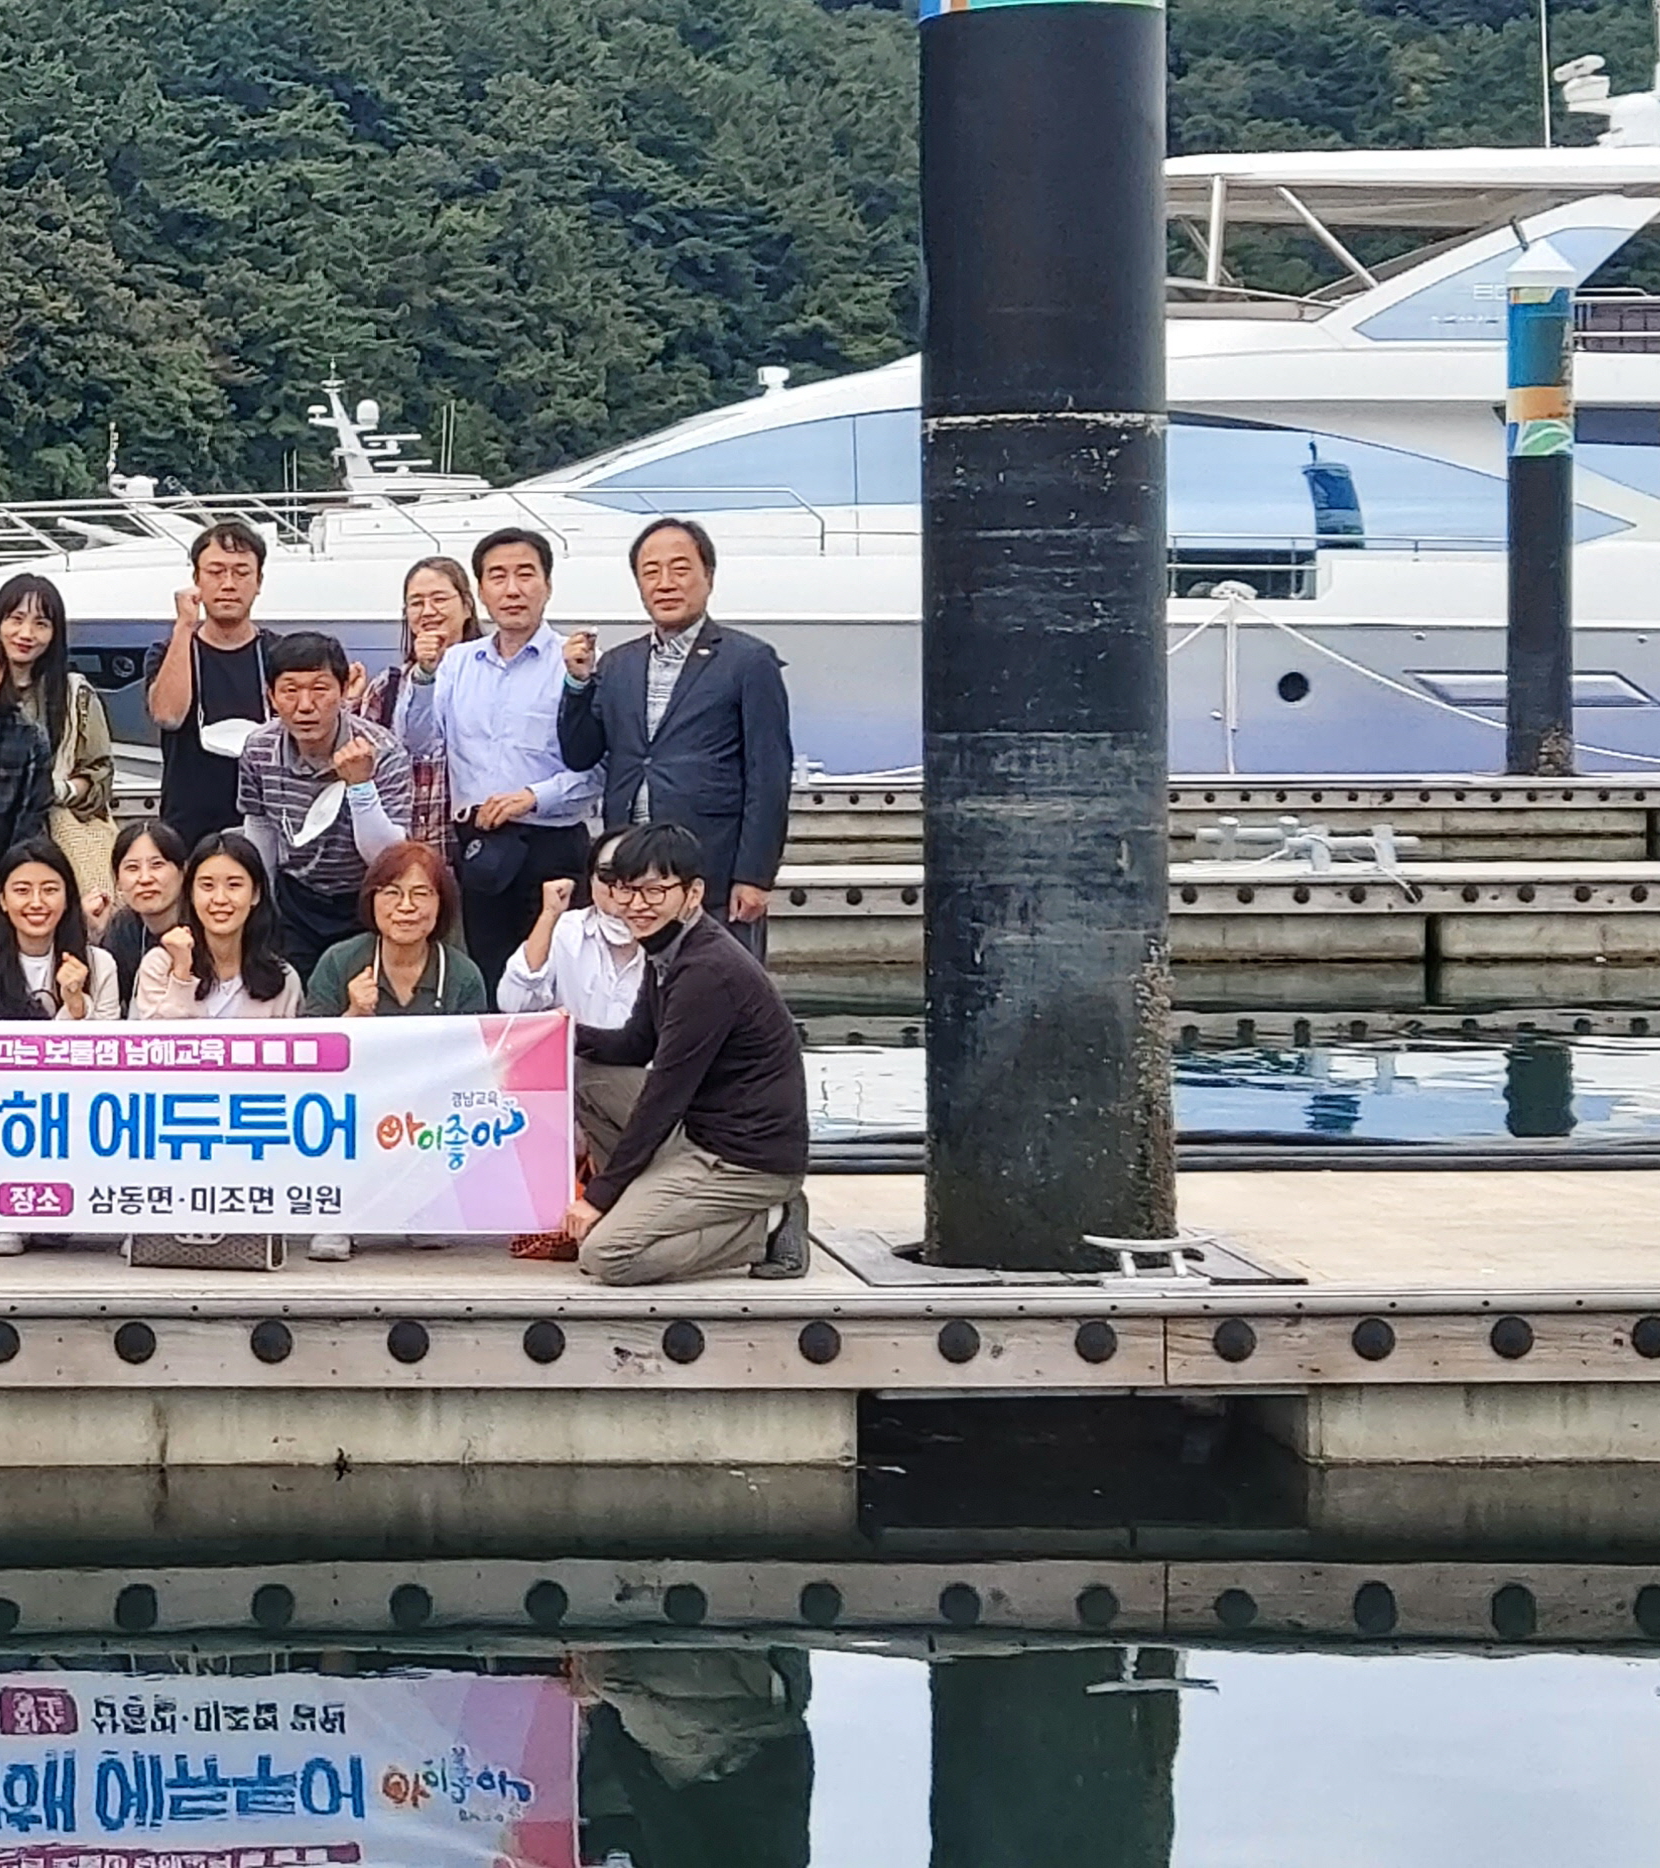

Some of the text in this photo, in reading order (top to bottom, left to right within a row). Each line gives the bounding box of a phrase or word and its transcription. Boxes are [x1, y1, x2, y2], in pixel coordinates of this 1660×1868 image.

[43, 1038, 119, 1067] 보물섬
[125, 1038, 226, 1067] 남해교육
[88, 1091, 357, 1161] 에듀투어
[376, 1108, 526, 1171] 아이좋아
[8, 1185, 342, 1215] 장소 삼동면·미조면 일원
